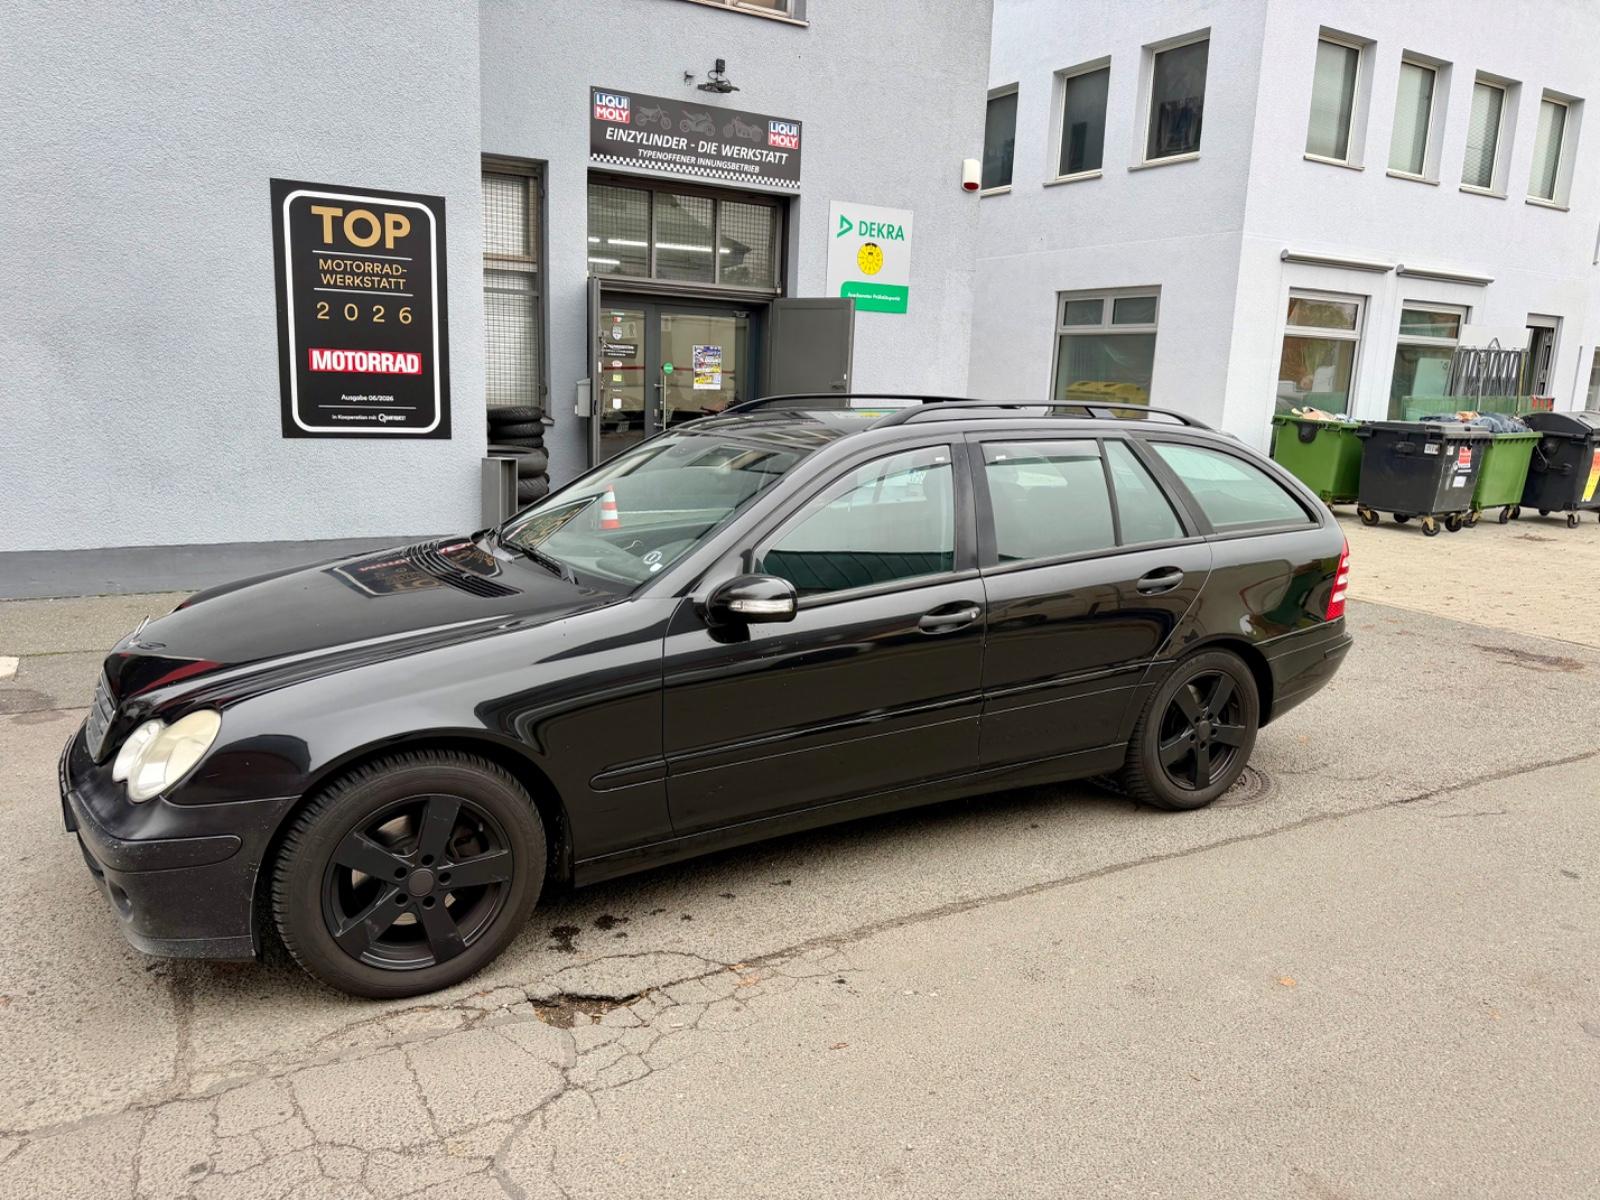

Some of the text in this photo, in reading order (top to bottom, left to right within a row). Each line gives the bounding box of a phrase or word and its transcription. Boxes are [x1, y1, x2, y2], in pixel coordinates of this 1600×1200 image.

[595, 93, 628, 109] LIQUI
[595, 107, 629, 122] MOLY
[769, 122, 798, 136] LIQUI
[605, 127, 687, 150] EINZYLINDER
[698, 141, 719, 156] DIE
[721, 146, 789, 165] WERKSTATT
[769, 134, 799, 149] MOLY
[638, 149, 760, 173] TYPENOFFENER INNUNGSBETRIEB
[310, 205, 411, 249] TOP
[859, 221, 904, 241] DEKRA
[319, 258, 408, 276] MOTORRAD-
[320, 273, 407, 290] WERKSTATT
[311, 350, 420, 374] MOTORRAD
[341, 393, 368, 402] Ausgabe
